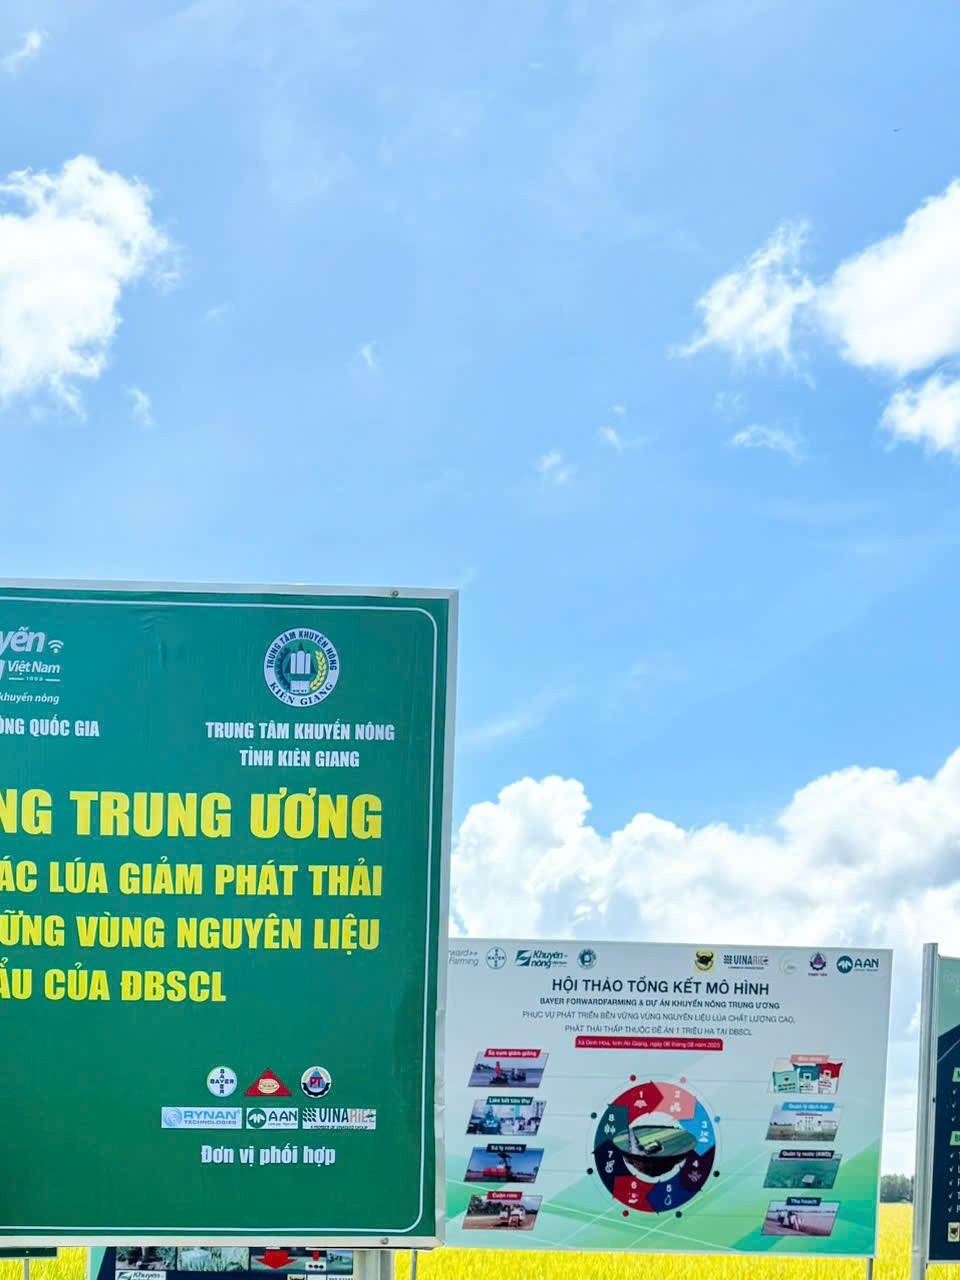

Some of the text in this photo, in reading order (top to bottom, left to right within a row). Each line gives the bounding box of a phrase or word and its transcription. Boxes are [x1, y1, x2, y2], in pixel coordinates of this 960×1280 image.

[8, 660, 60, 675] Việt Nam
[29, 714, 70, 736] QUỐC
[75, 720, 100, 737] GIA
[206, 718, 395, 740] TRUNG TÂM KHUYẾN NÔNG
[240, 746, 360, 767] TỈNH KIÊN GIANG
[70, 790, 232, 838] TRUNG
[250, 786, 383, 839] ƯƠNG
[50, 856, 108, 894] LÚA
[119, 855, 203, 896] GIẢM
[215, 858, 298, 896] PHÁT
[308, 857, 382, 896] THẢI
[76, 912, 165, 948] VÙNG
[177, 913, 302, 950] NGUYÊN
[314, 913, 380, 955] LIỆU
[854, 958, 879, 969] AAN
[44, 962, 110, 1001] CỦA
[120, 970, 226, 1002] ĐBSCL
[552, 976, 769, 995] HỘI THẢO TỔNG KẾT MÔ HÌNH
[540, 998, 564, 1006] BAYER
[728, 1001, 754, 1009] TRUNG
[310, 1077, 322, 1087] PT
[184, 1111, 237, 1120] RYNAN
[269, 1110, 297, 1122] AAN
[609, 1114, 614, 1122] 8
[201, 1143, 336, 1167] Đơn vị phối hợp
